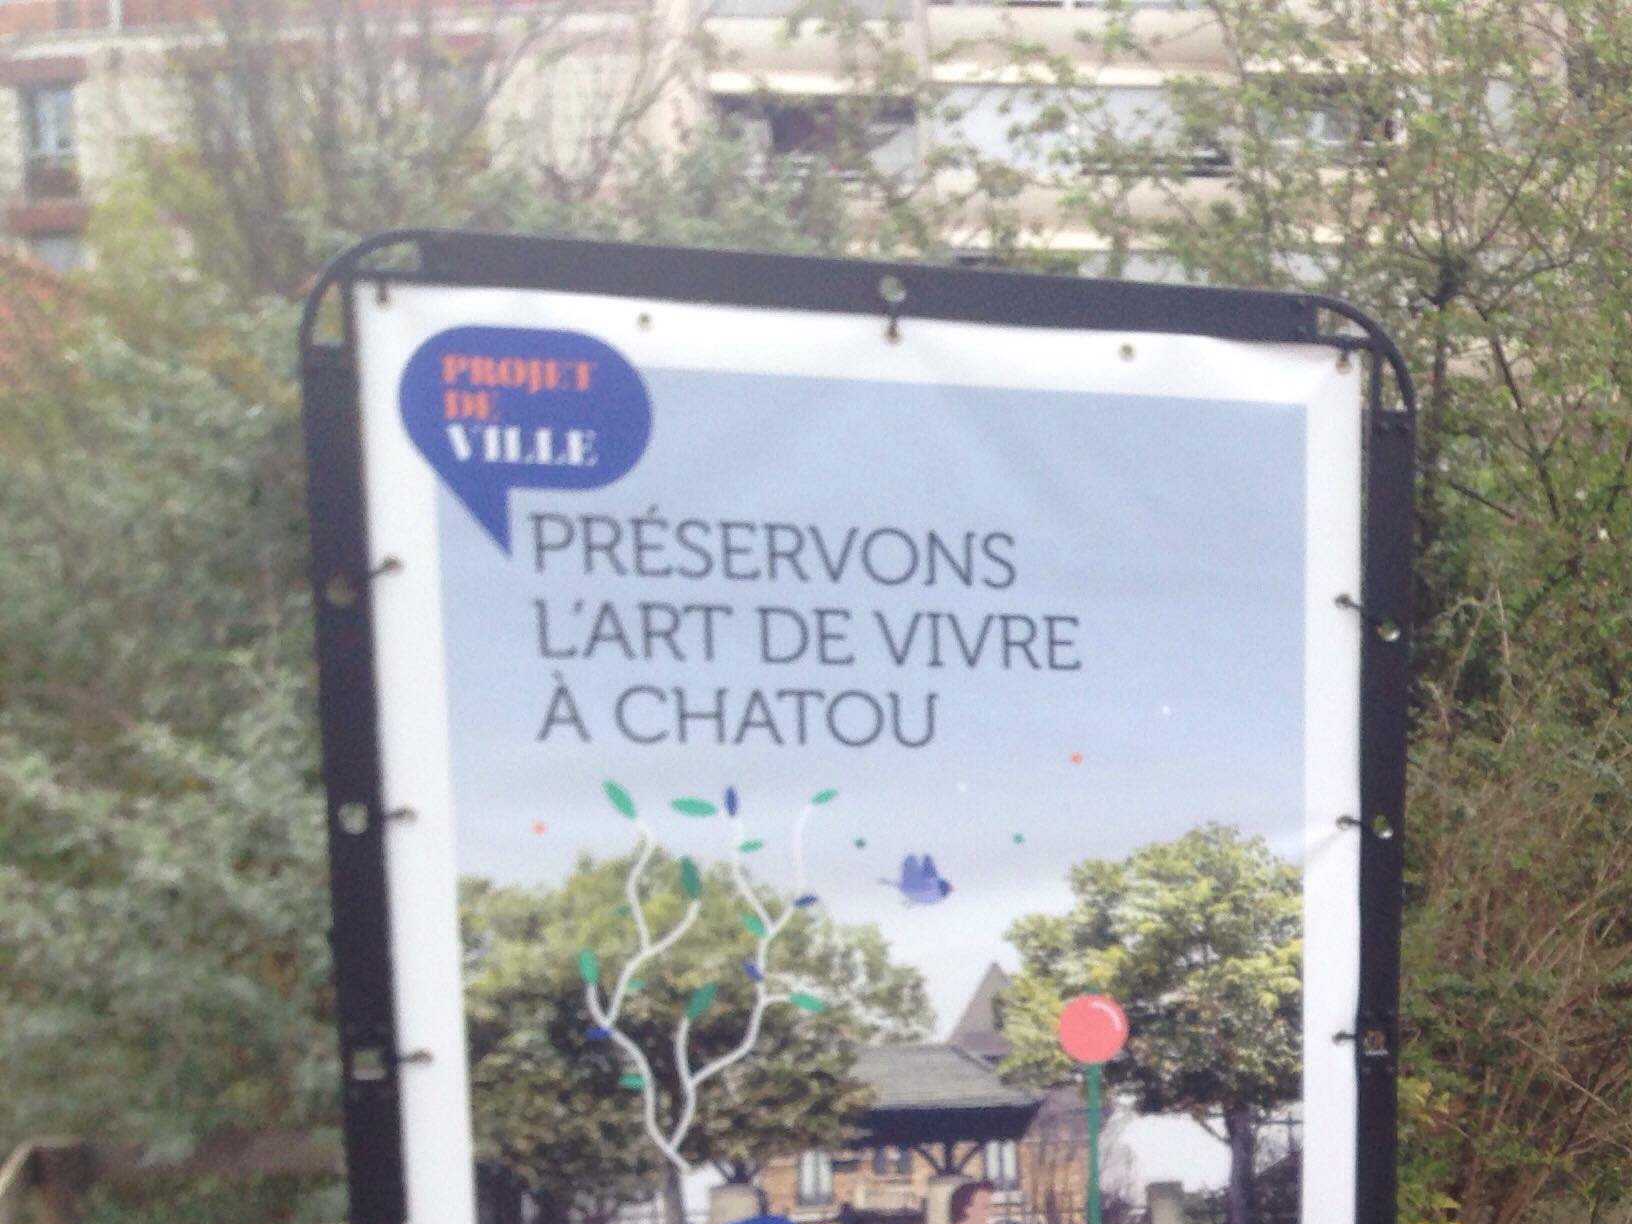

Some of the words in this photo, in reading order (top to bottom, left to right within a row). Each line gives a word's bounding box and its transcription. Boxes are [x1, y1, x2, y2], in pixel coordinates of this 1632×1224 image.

[441, 353, 598, 394] PROJET
[443, 387, 500, 423] DE
[445, 422, 600, 468] VILLE
[528, 505, 1018, 590] PRÉSERVONS
[533, 600, 732, 662] L'ART
[759, 606, 855, 666] DE
[875, 610, 1082, 671] VIVRE
[535, 671, 592, 743] À
[616, 685, 940, 749] CHATOU
